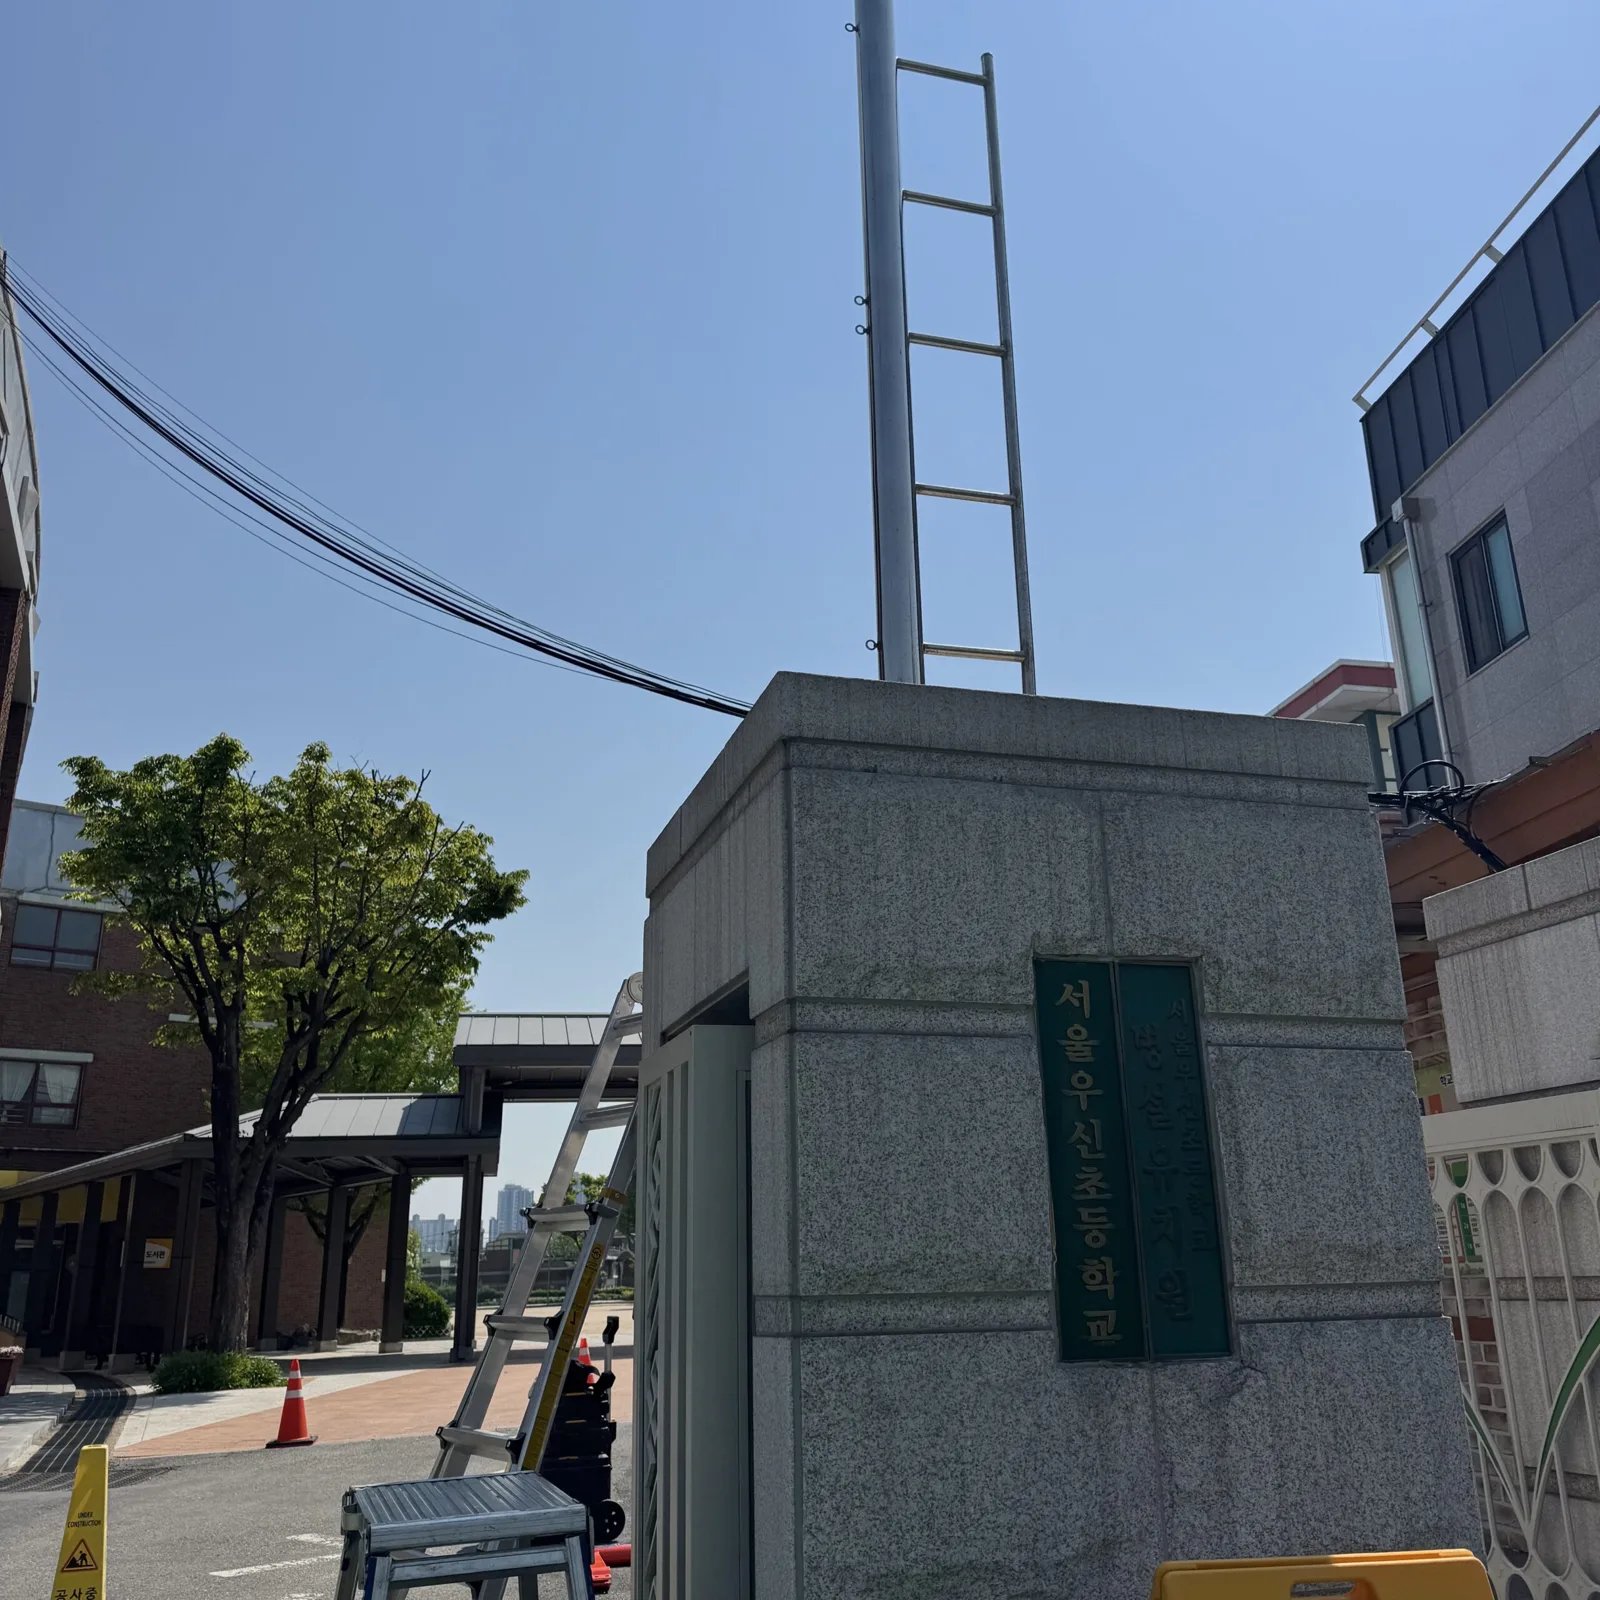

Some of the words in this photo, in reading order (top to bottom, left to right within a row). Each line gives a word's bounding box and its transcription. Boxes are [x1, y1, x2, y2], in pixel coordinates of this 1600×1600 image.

[1055, 979, 1122, 1343] 서울우신초등학교
[1131, 1023, 1194, 1322] 병설유치원
[146, 1250, 165, 1259] 도서관
[67, 1520, 102, 1528] CONSTRUCTION
[55, 1587, 98, 1600] 공사중
